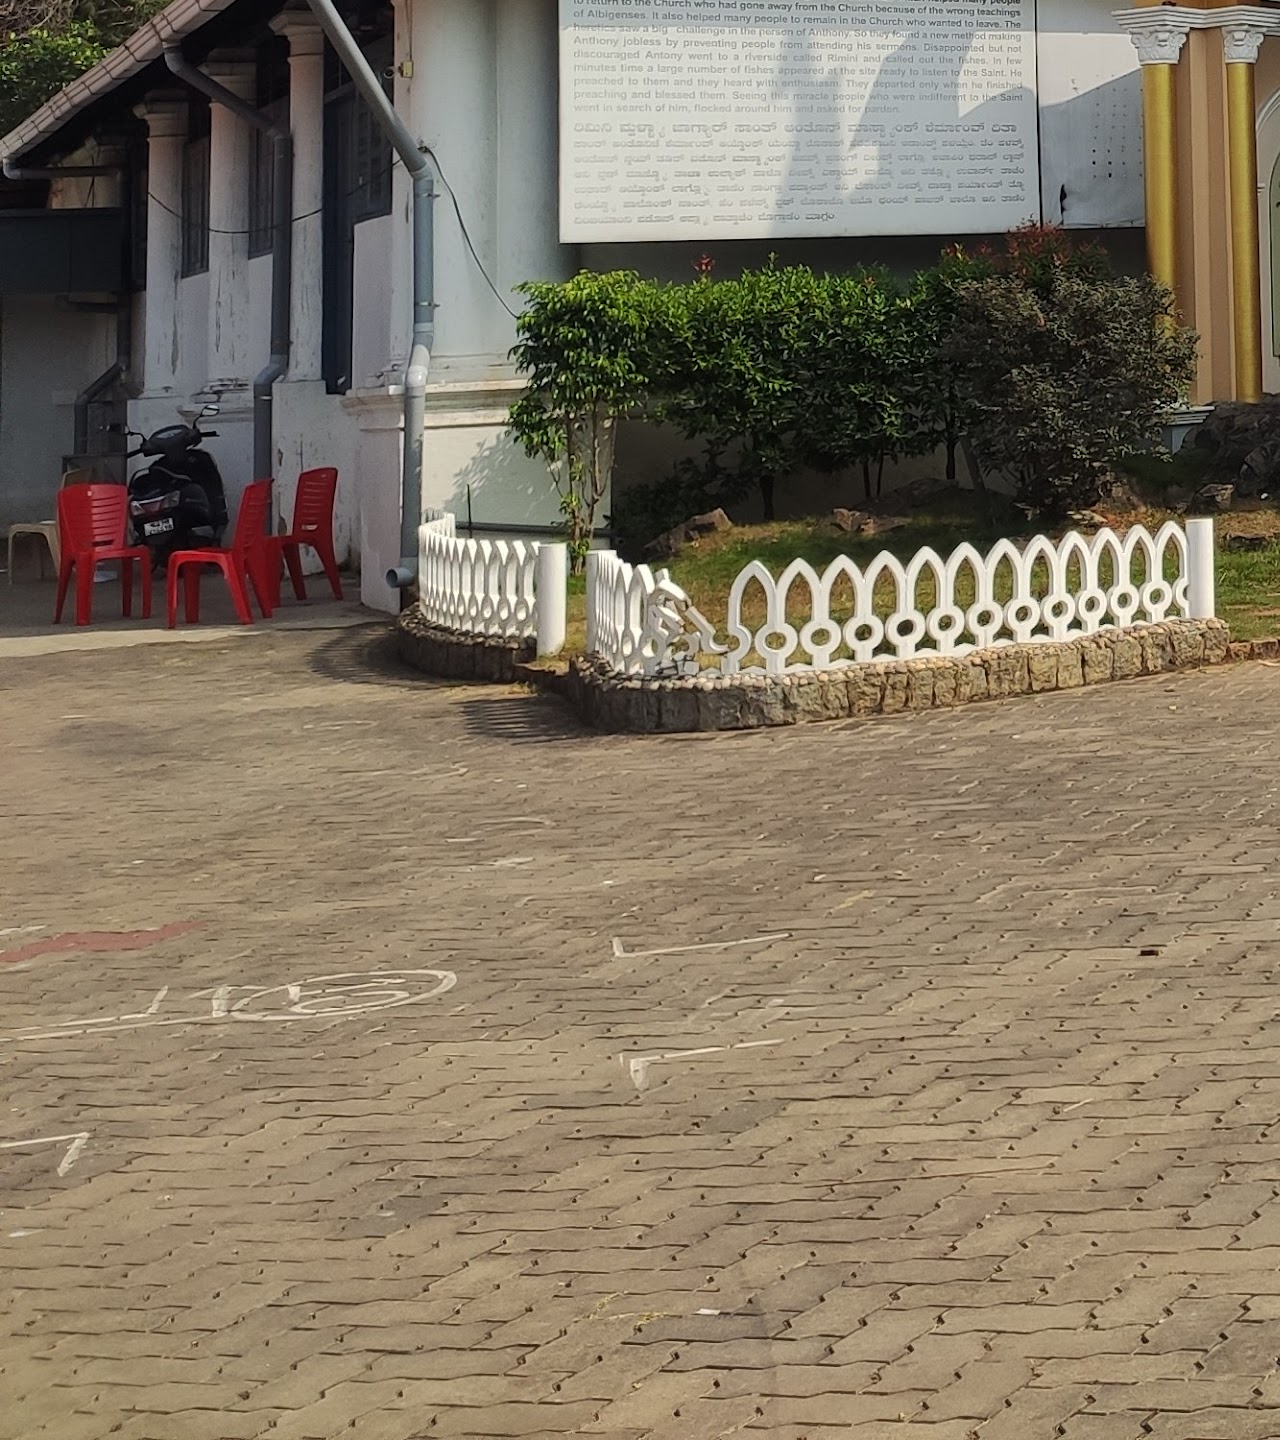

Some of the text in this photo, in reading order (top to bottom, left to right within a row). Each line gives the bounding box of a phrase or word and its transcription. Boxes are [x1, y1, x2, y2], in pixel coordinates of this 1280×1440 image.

[693, 0, 715, 8] who
[718, 0, 736, 9] had
[739, 3, 764, 12] gone
[767, 4, 792, 12] away
[794, 2, 817, 11] from
[820, 3, 835, 12] the
[837, 3, 873, 13] Church
[875, 4, 915, 14] because
[917, 6, 927, 14] of
[928, 6, 943, 14] the
[945, 9, 974, 17] wrong
[976, 7, 1021, 18] teachings
[573, 9, 583, 18] of
[652, 11, 659, 20] It
[661, 11, 683, 20] also
[686, 12, 720, 23] helped
[723, 15, 751, 24] many
[754, 13, 787, 25] people
[790, 15, 800, 23] to
[802, 15, 836, 24] remain
[839, 16, 848, 24] in
[850, 16, 866, 25] the
[868, 16, 903, 26] Church
[905, 17, 926, 26] who
[927, 18, 961, 27] wanted
[1004, 20, 1021, 28] The
